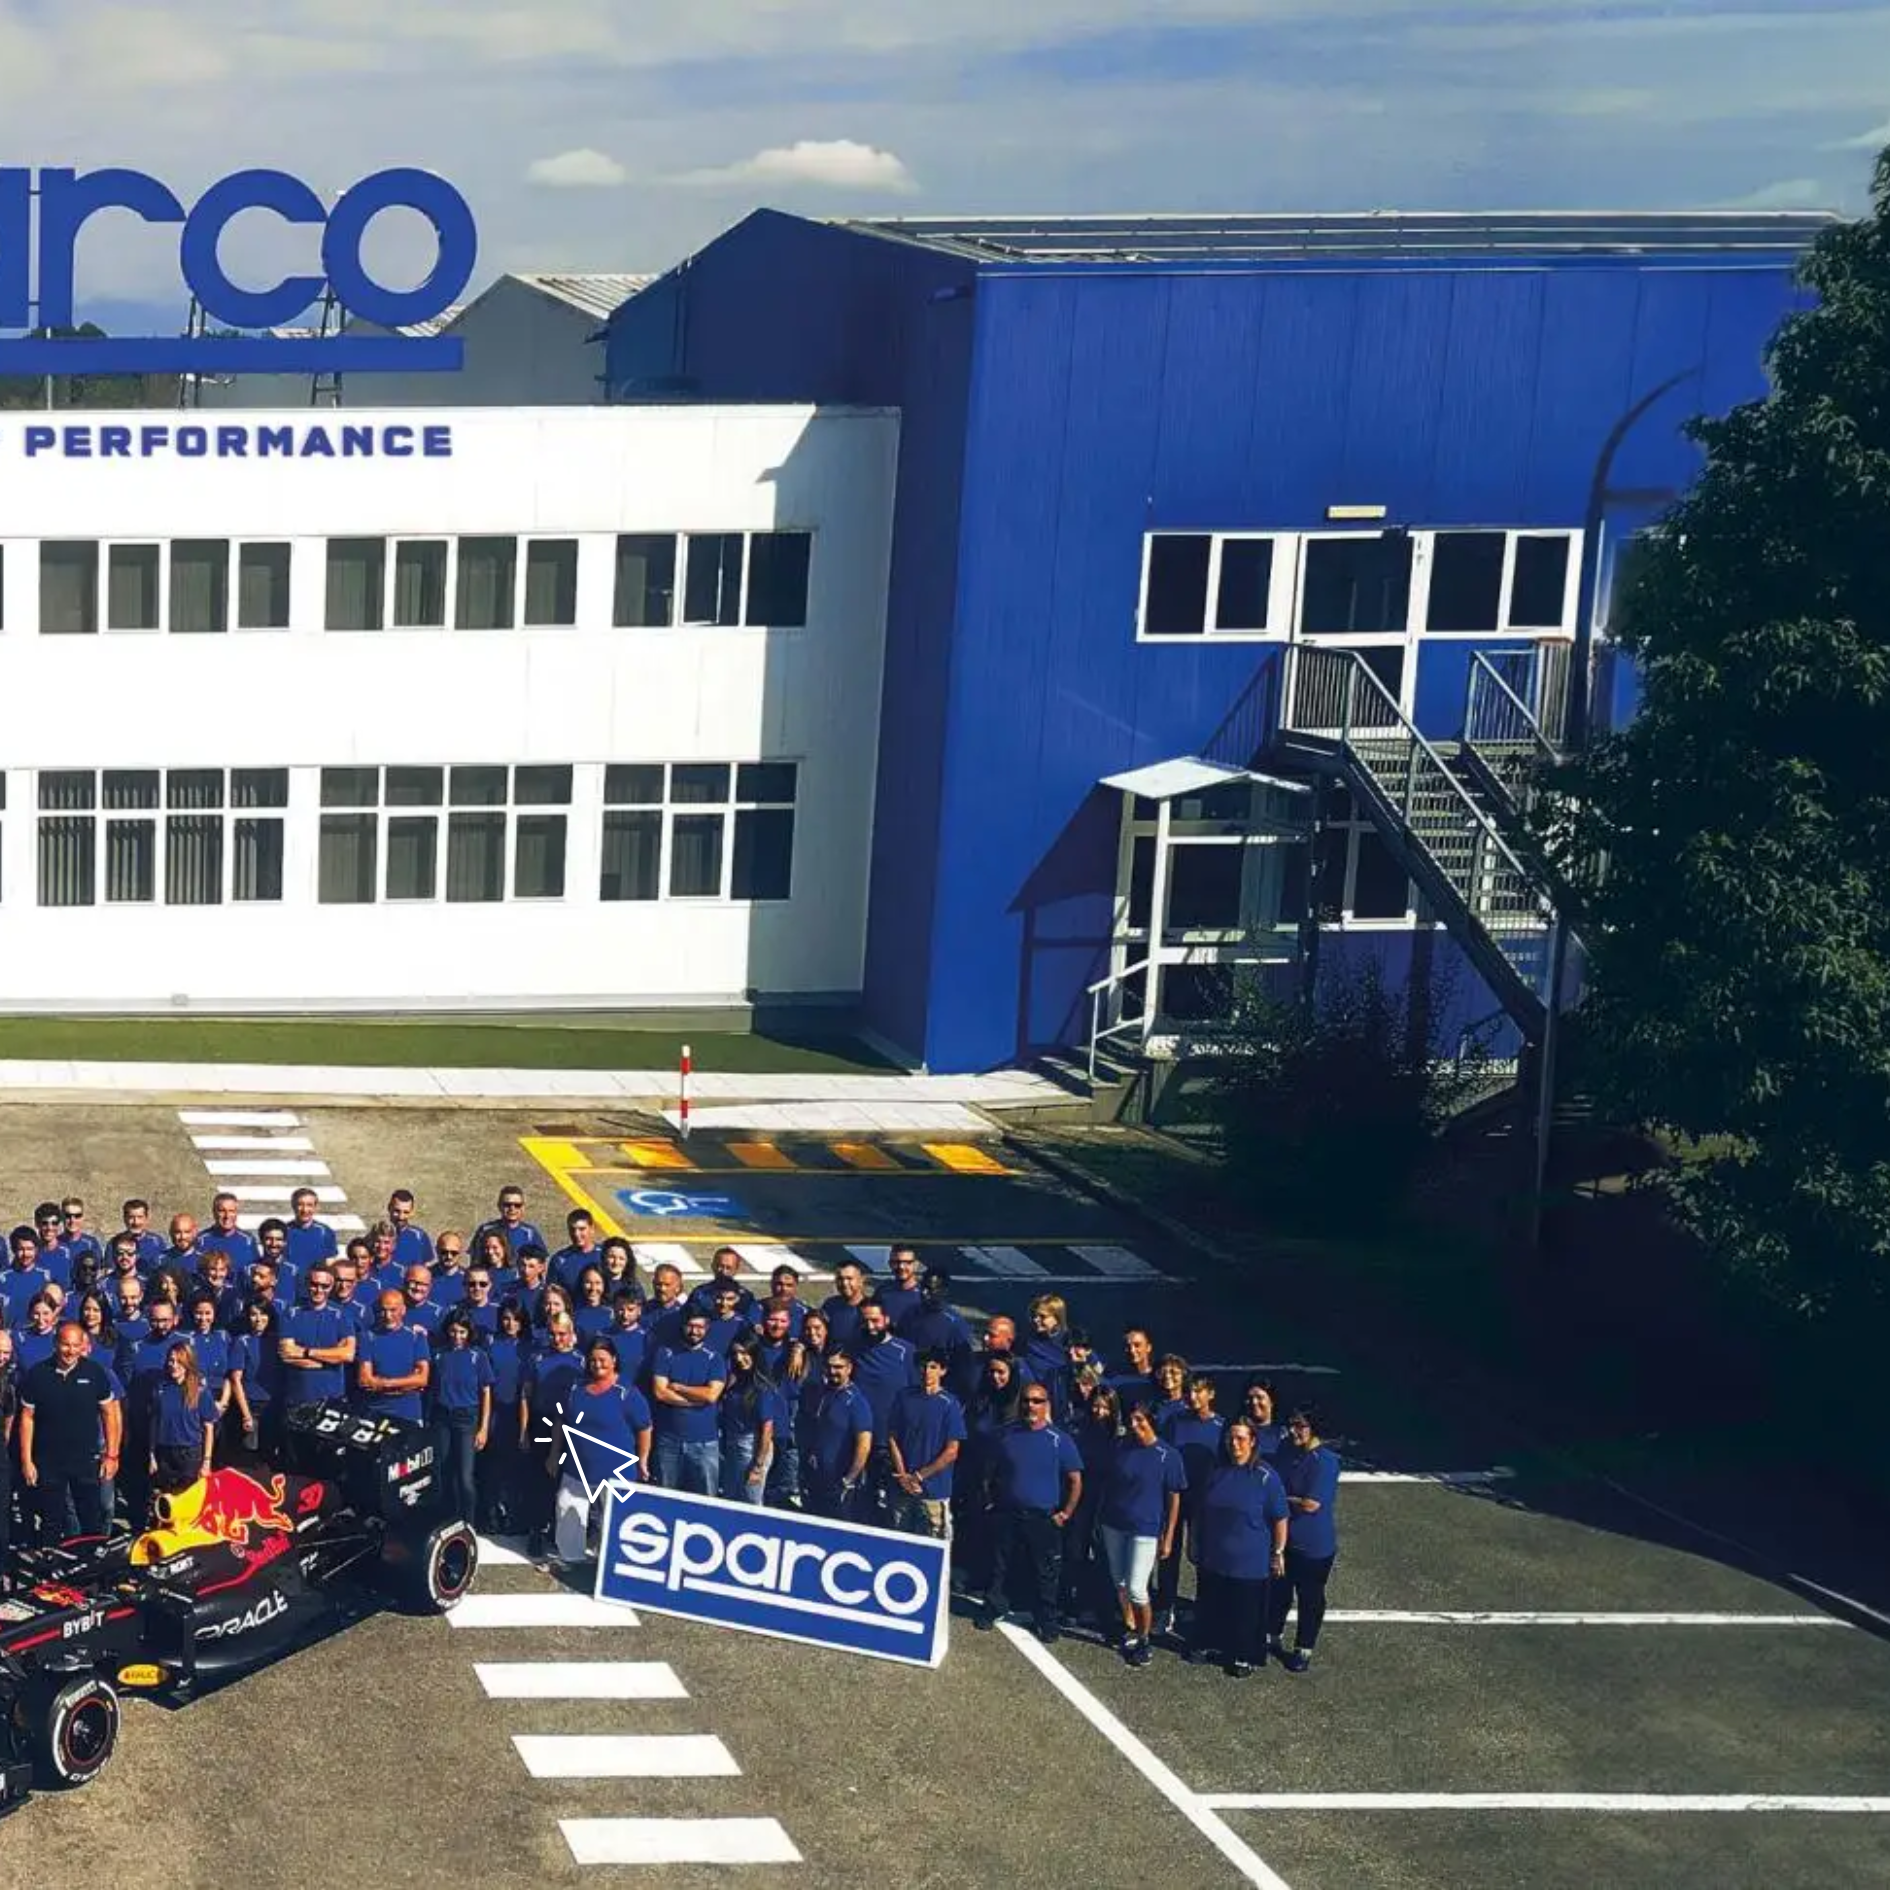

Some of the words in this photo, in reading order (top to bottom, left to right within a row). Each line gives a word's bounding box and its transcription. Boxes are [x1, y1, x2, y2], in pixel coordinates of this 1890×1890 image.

[24, 425, 454, 458] PERFORMANCE
[618, 1512, 929, 1616] sparco
[63, 1610, 106, 1639] BYBIT
[194, 1590, 288, 1640] ORACLE
